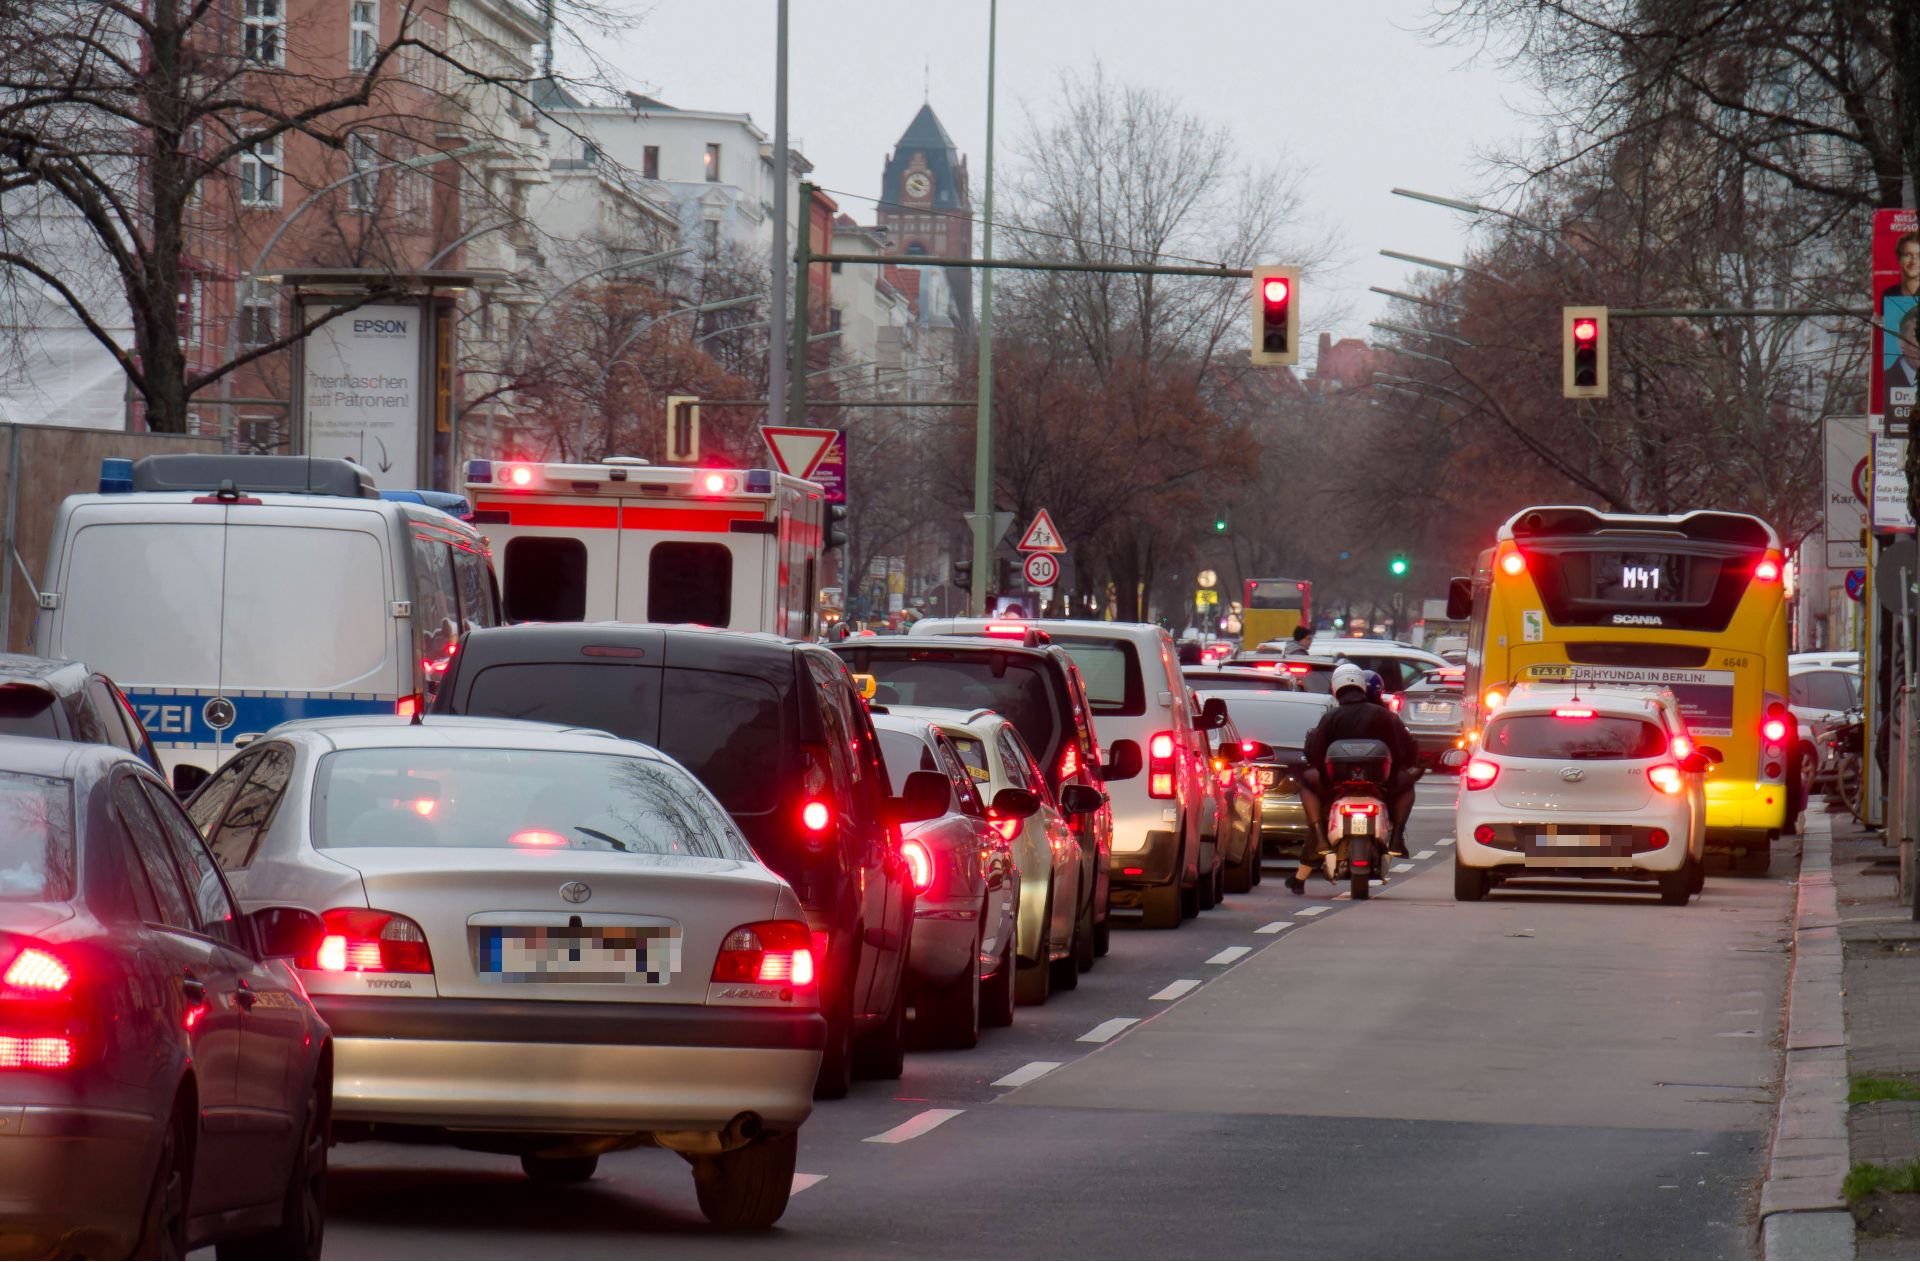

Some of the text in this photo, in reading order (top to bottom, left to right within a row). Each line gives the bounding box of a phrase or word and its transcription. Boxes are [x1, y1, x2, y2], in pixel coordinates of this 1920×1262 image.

[353, 319, 407, 334] EPSON
[335, 392, 409, 408] Patronen!
[1895, 391, 1911, 401] Dr.
[1032, 562, 1051, 577] 30
[1623, 567, 1659, 589] M41
[1613, 614, 1662, 625] SCANIA
[1722, 658, 1748, 668] 4648
[1536, 667, 1563, 675] TAXI
[1594, 669, 1645, 681] HYUNDAI
[1648, 671, 1660, 682] IN
[1663, 672, 1705, 684] BERLIN!
[366, 978, 412, 989] TOYOTA
